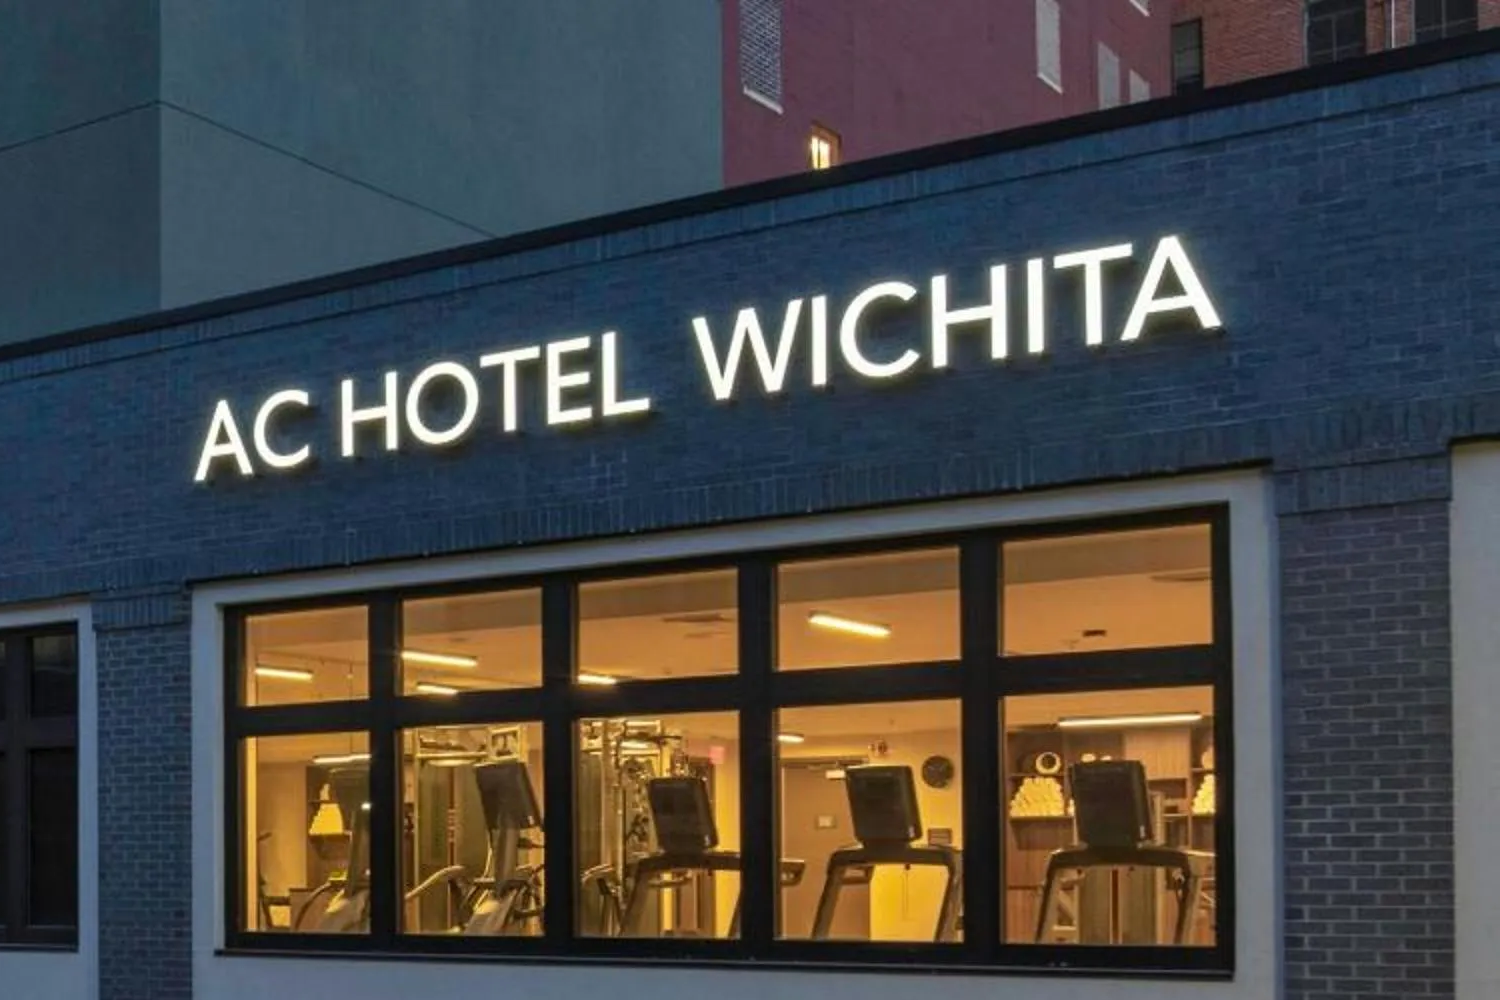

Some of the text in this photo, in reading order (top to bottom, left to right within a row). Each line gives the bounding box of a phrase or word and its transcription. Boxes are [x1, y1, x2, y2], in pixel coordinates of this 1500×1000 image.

[194, 235, 1222, 481] AC HOTEL WICHITA
